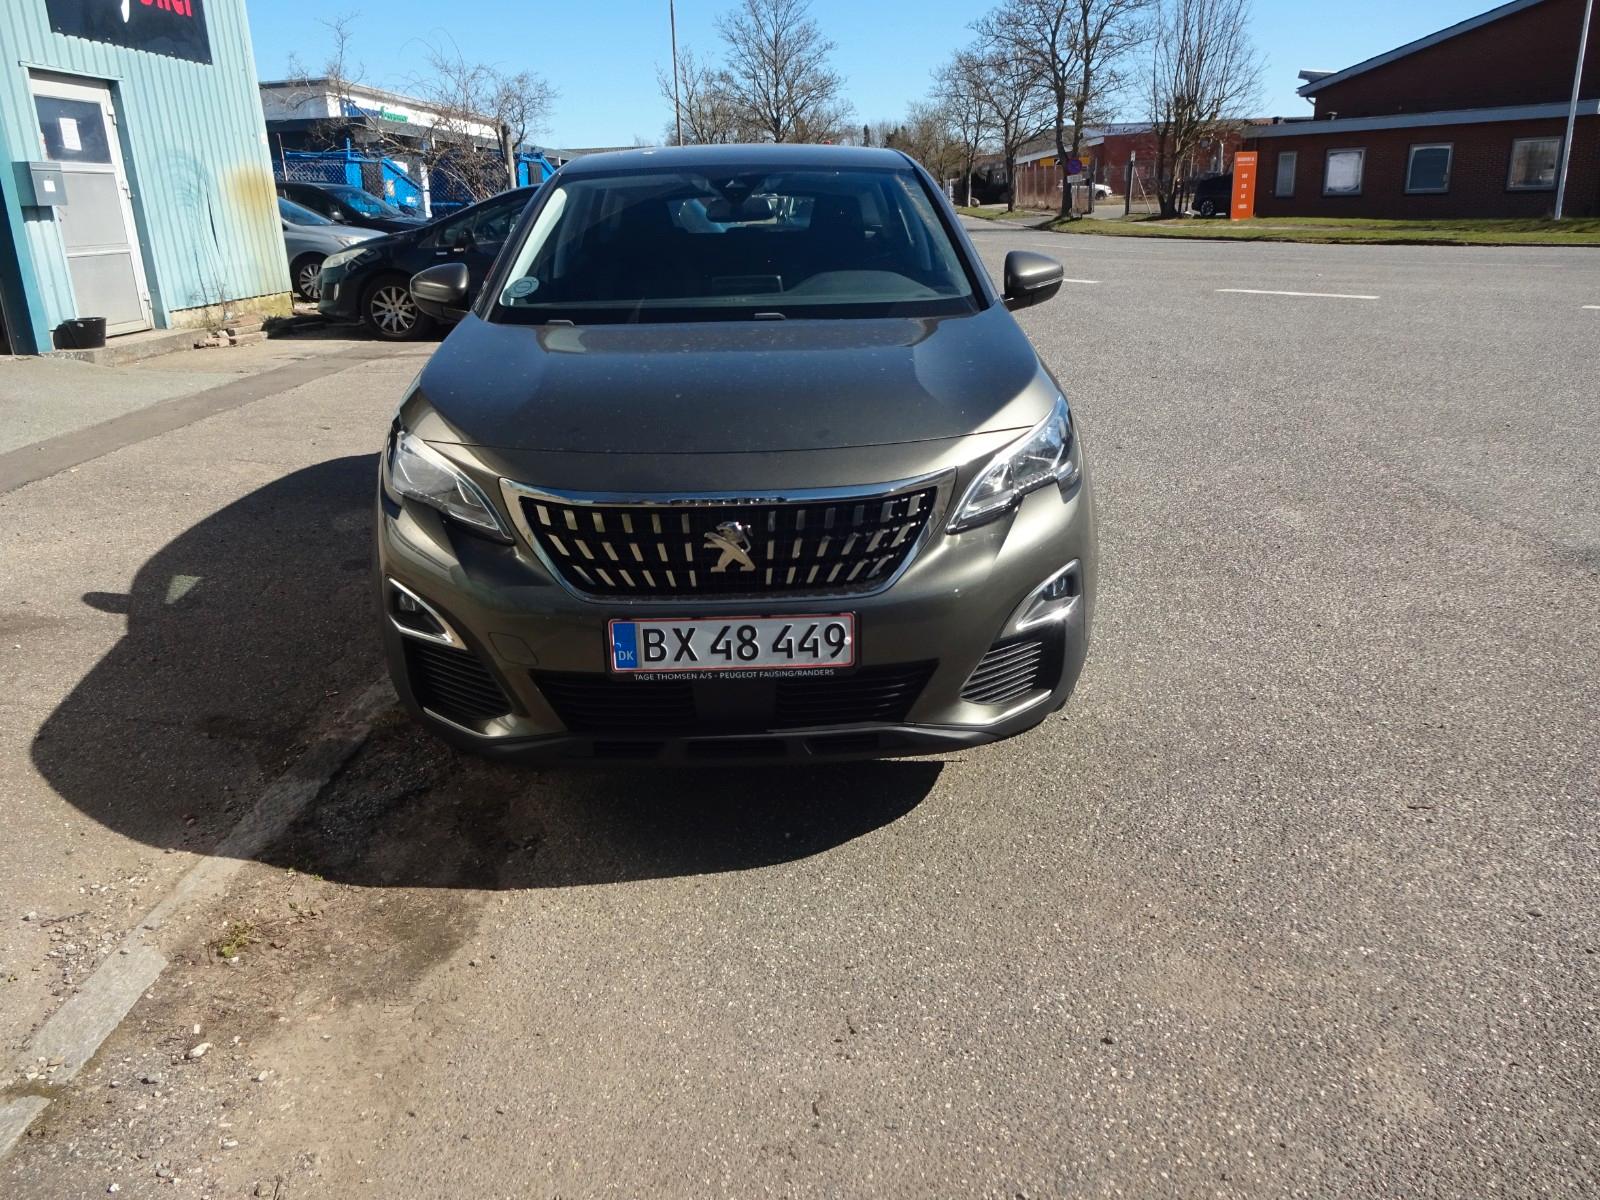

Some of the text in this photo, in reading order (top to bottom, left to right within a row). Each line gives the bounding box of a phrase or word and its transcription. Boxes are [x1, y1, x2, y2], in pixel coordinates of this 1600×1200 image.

[642, 622, 847, 662] BX 48 449
[618, 650, 634, 661] DK
[634, 673, 654, 681] TAGE
[657, 672, 697, 680] THOMSEN
[700, 672, 713, 680] A/S
[720, 671, 757, 680] PEUGEOT
